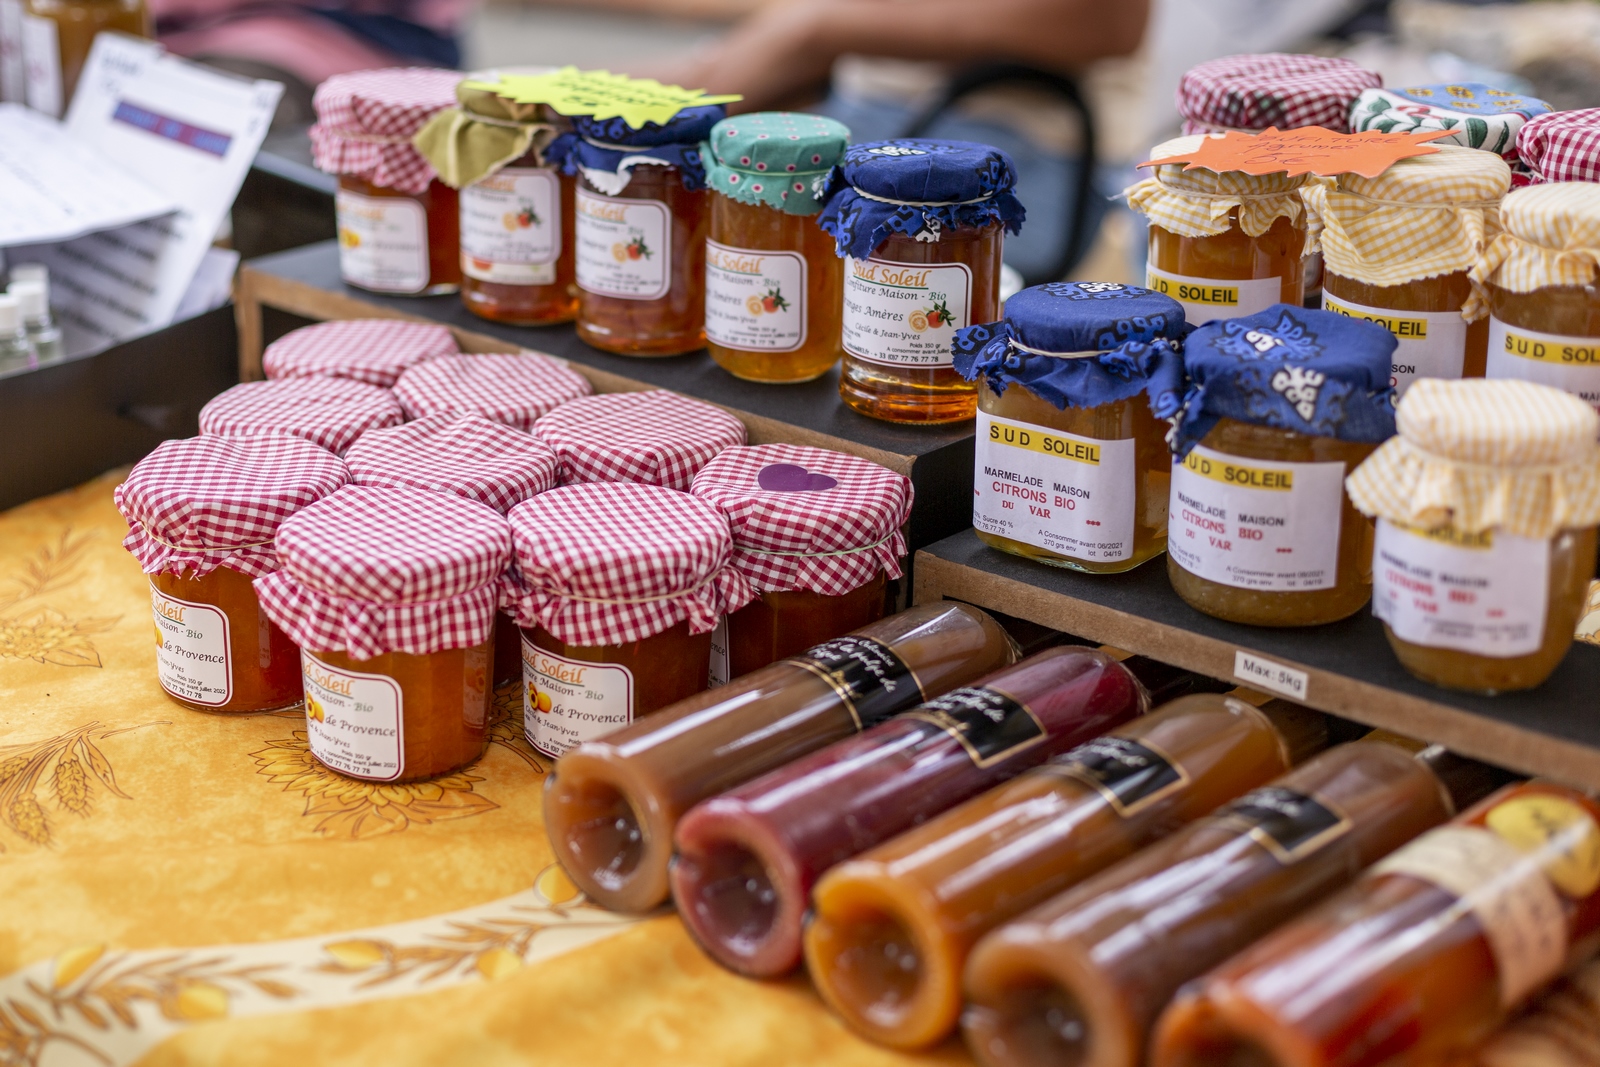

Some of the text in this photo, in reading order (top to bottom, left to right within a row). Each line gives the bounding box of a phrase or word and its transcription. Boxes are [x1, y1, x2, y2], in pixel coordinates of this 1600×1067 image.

[721, 254, 765, 274] Soleil
[852, 261, 932, 287] Sud Soleil
[847, 276, 876, 295] Confiture
[878, 288, 919, 300] Maison
[928, 291, 947, 301] Bio
[1179, 285, 1238, 303] SOLEIL
[864, 306, 904, 321] Amères
[873, 328, 879, 336] &
[879, 329, 921, 341] Jean-Yves
[1043, 437, 1100, 463] SOLEIL
[984, 466, 1090, 500] MARMELADE MAISON
[1224, 466, 1292, 488] SOLEIL
[992, 481, 1076, 511] CITRONS BIO
[982, 514, 998, 525] Sucre
[1002, 500, 1051, 519] DU VAR
[1178, 491, 1285, 527] MARMELADE MAISON
[1182, 509, 1263, 541] CITRONS BIO
[1043, 529, 1079, 545] Consommer
[1079, 540, 1096, 549] avant
[1043, 538, 1055, 547] 370
[1055, 541, 1065, 551] grs
[1066, 544, 1077, 553] env
[1185, 529, 1233, 551] DU VAR
[186, 629, 203, 640] Bio
[163, 640, 224, 664] de Provence
[710, 642, 725, 656] ence
[315, 668, 355, 695] Soleil
[540, 659, 587, 684] Soleil
[1278, 671, 1302, 692] 5kg
[315, 685, 345, 707] Maison
[353, 702, 373, 712] Bio
[540, 677, 574, 697] Maison
[585, 690, 604, 701] Bio
[553, 704, 626, 724] de Provence
[325, 714, 396, 737] de Provence
[542, 719, 579, 737] Jean-Yves
